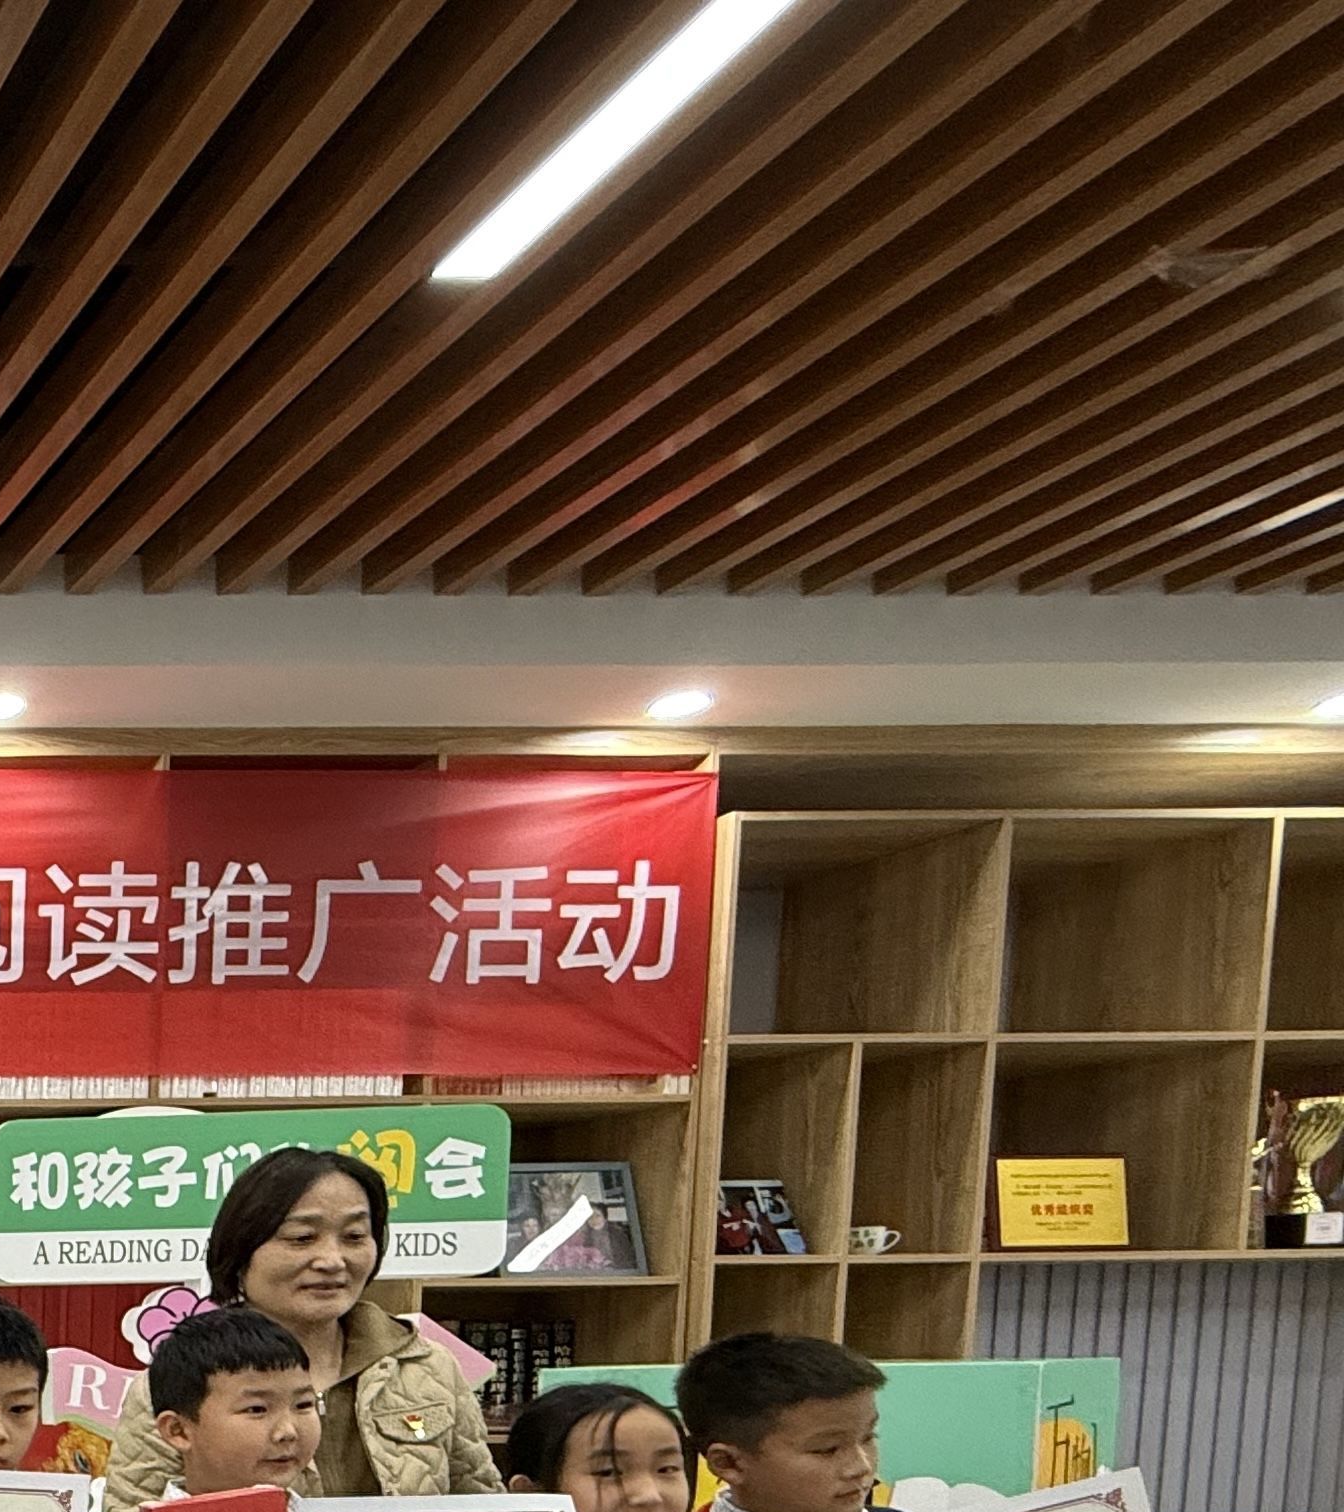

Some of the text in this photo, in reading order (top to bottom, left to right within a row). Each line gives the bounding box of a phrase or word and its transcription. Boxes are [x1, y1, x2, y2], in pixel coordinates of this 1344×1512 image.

[33, 1231, 459, 1265] A READING DA KIDS
